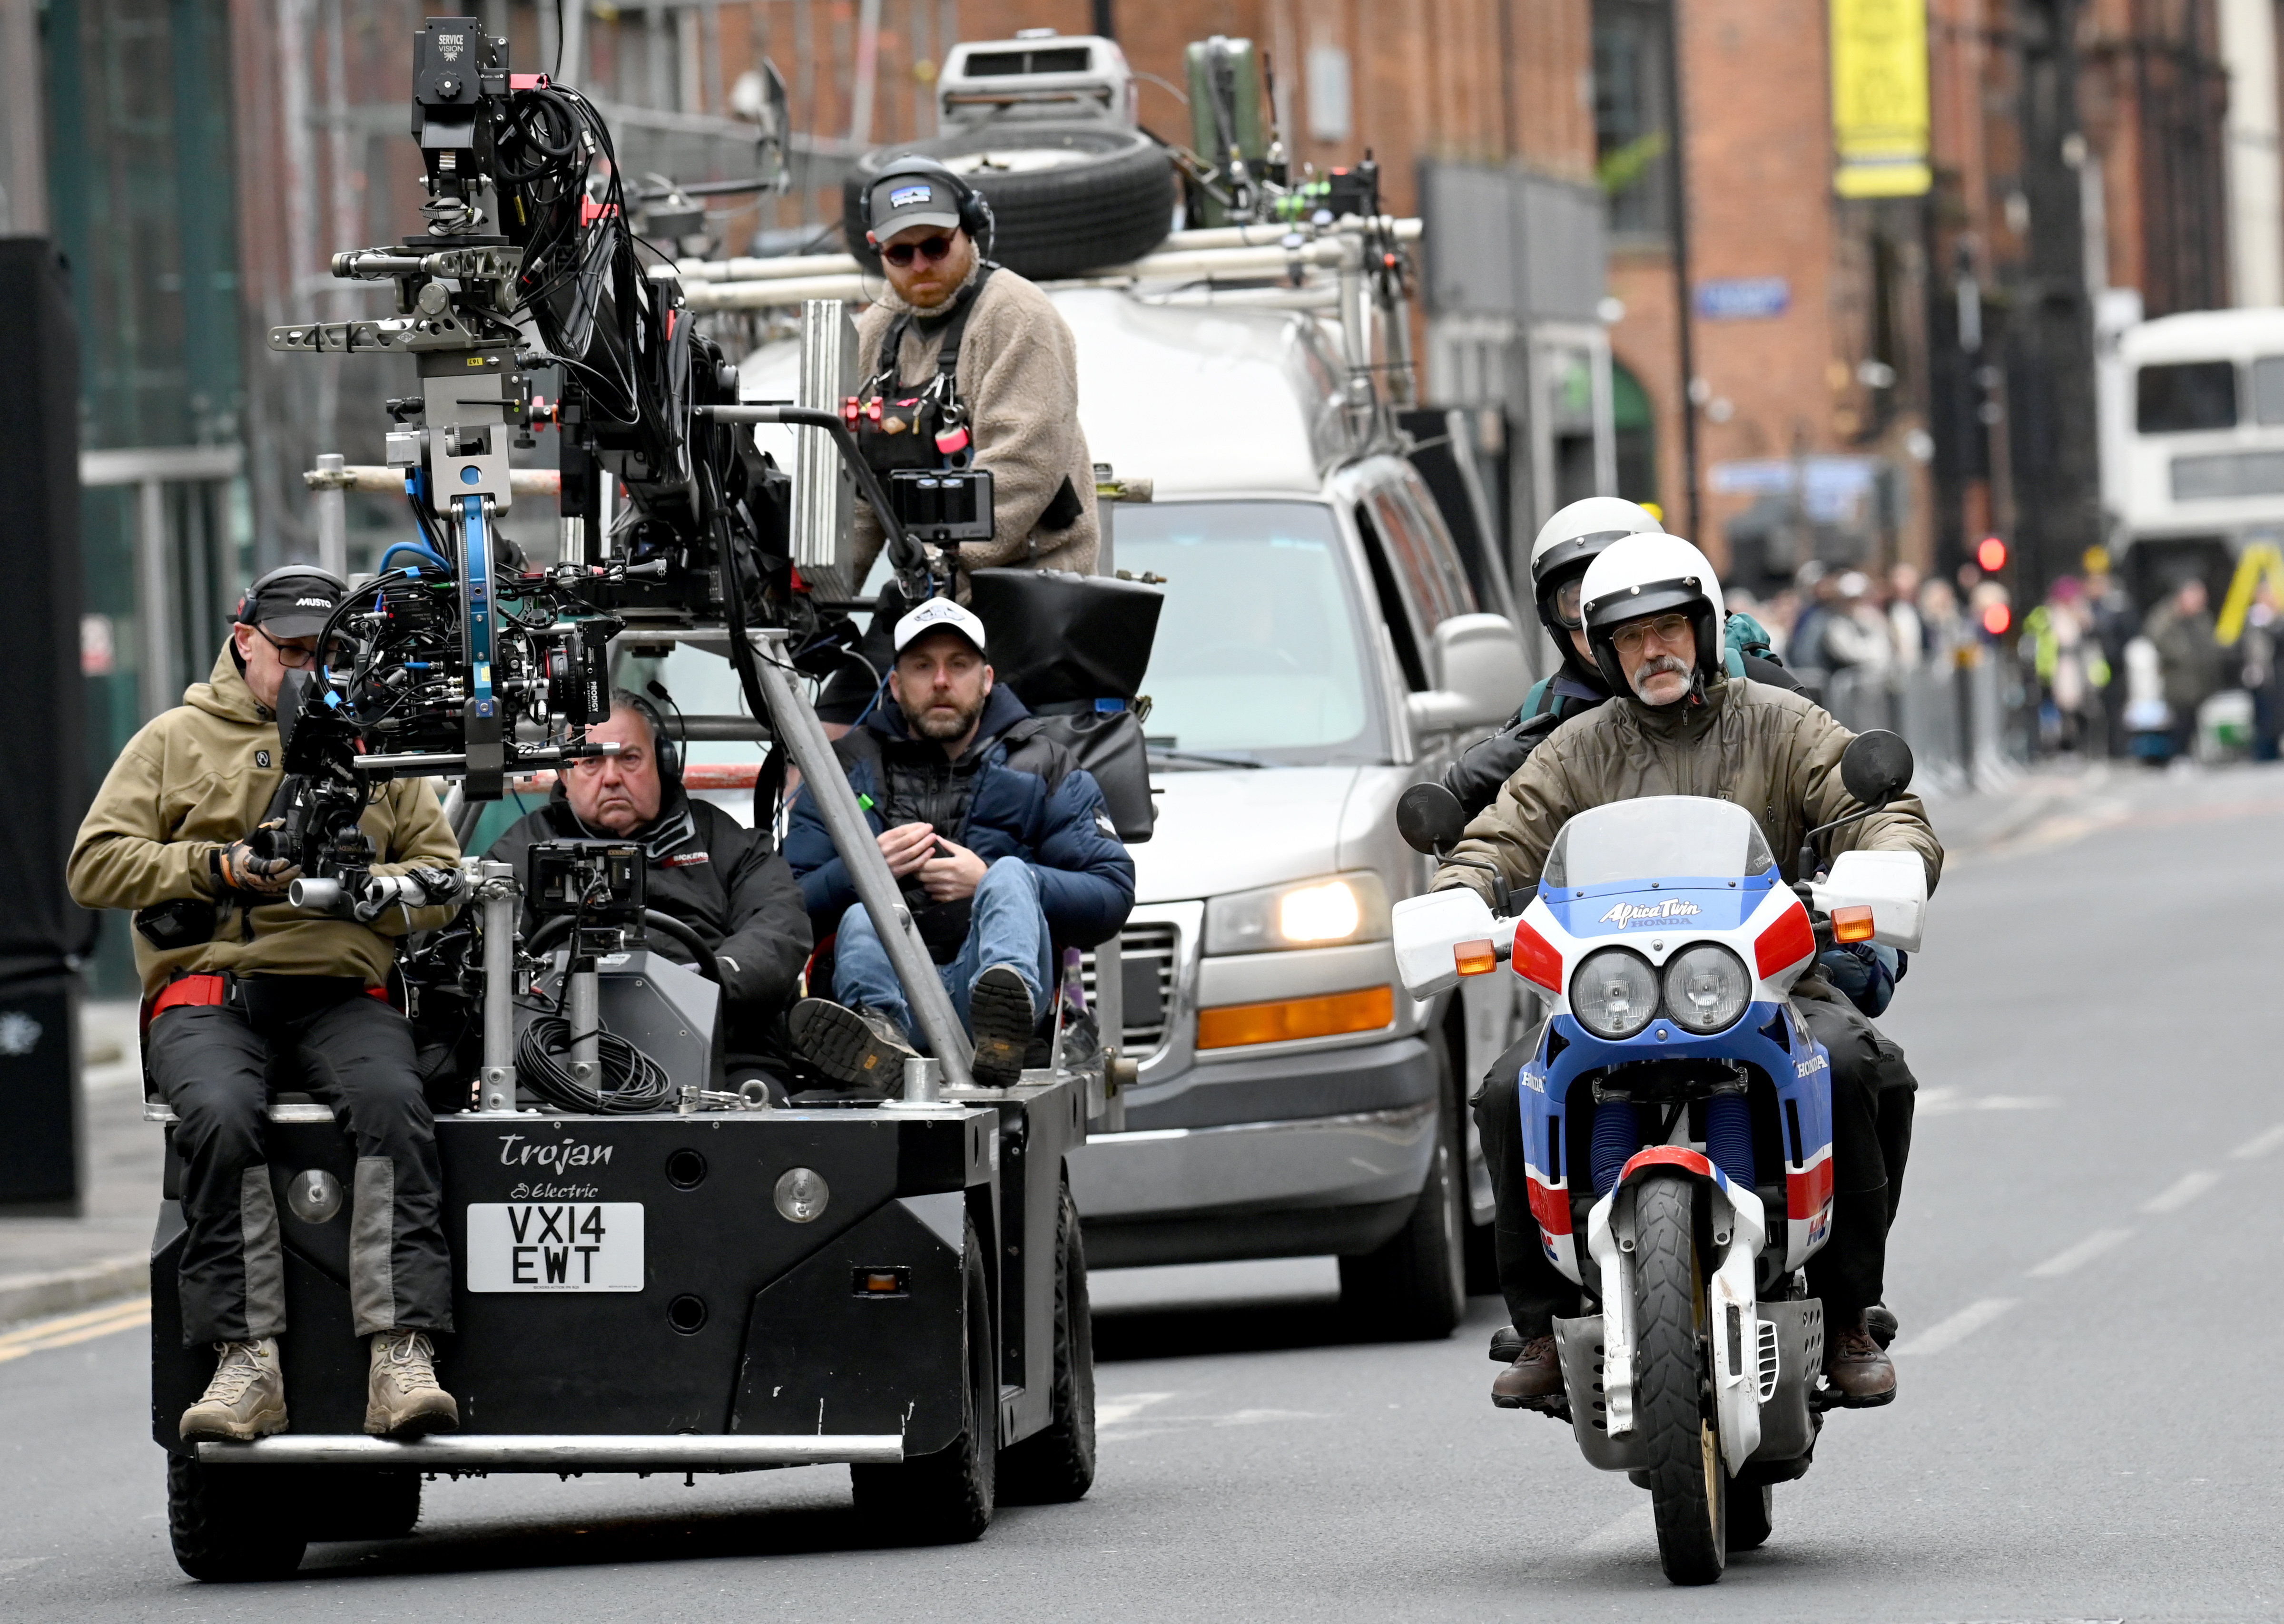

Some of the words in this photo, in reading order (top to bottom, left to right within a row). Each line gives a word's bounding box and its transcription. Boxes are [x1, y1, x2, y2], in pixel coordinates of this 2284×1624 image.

[439, 35, 463, 45] SERVICE
[295, 598, 332, 608] MUSTO
[590, 681, 598, 712] PRODIGY
[1598, 902, 1662, 929] Africa
[1659, 898, 1702, 918] Twin
[1631, 918, 1692, 927] HONDA
[1797, 1055, 1828, 1078] HONDA
[532, 1183, 599, 1198] Electric
[507, 1206, 605, 1243] VX14
[513, 1246, 600, 1283] EWT
